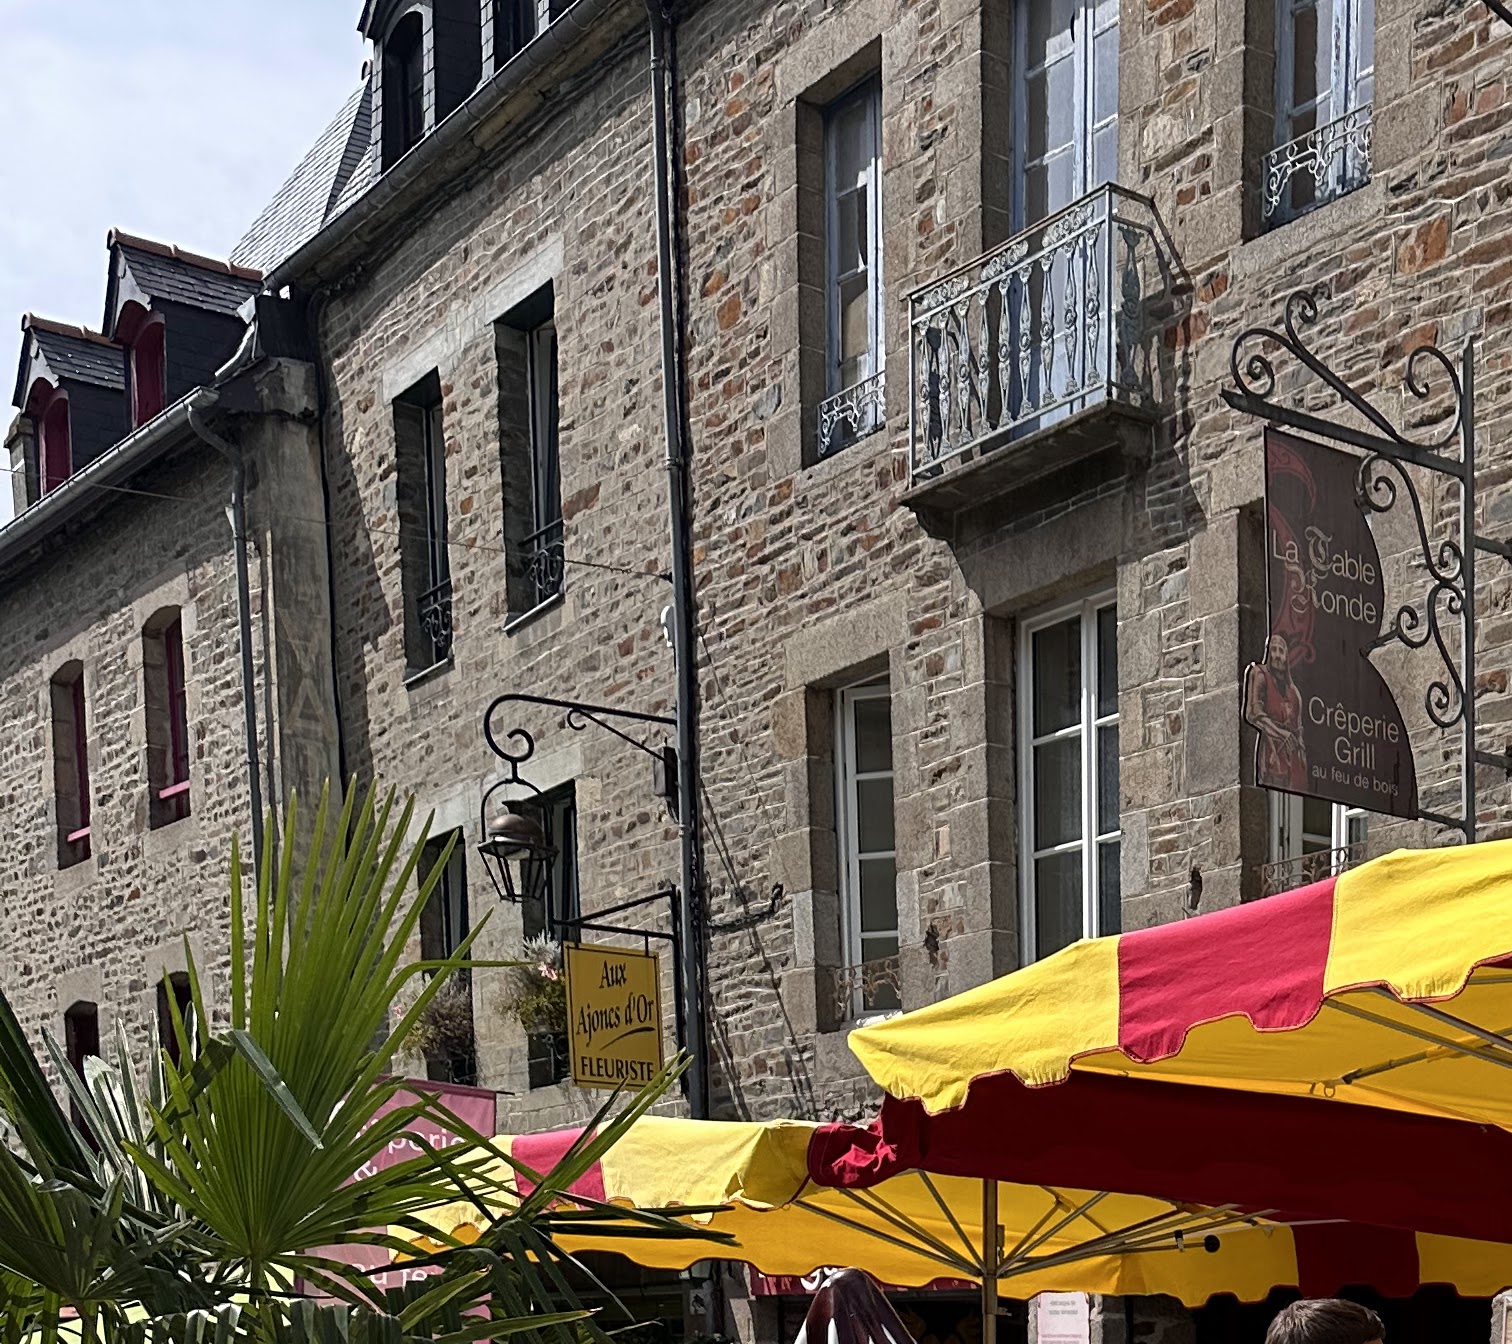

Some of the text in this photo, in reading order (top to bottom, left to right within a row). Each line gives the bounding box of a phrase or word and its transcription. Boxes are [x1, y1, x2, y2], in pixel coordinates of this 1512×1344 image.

[1272, 525, 1377, 586] La Table
[1290, 566, 1378, 624] Ronde
[1308, 696, 1400, 743] Crêperie
[1333, 737, 1377, 771] Grill
[1311, 765, 1400, 797] au feu de bois
[599, 960, 627, 989] Aux
[575, 991, 655, 1048] Ajoncs d'Or
[580, 1056, 655, 1082] FLEURISTE
